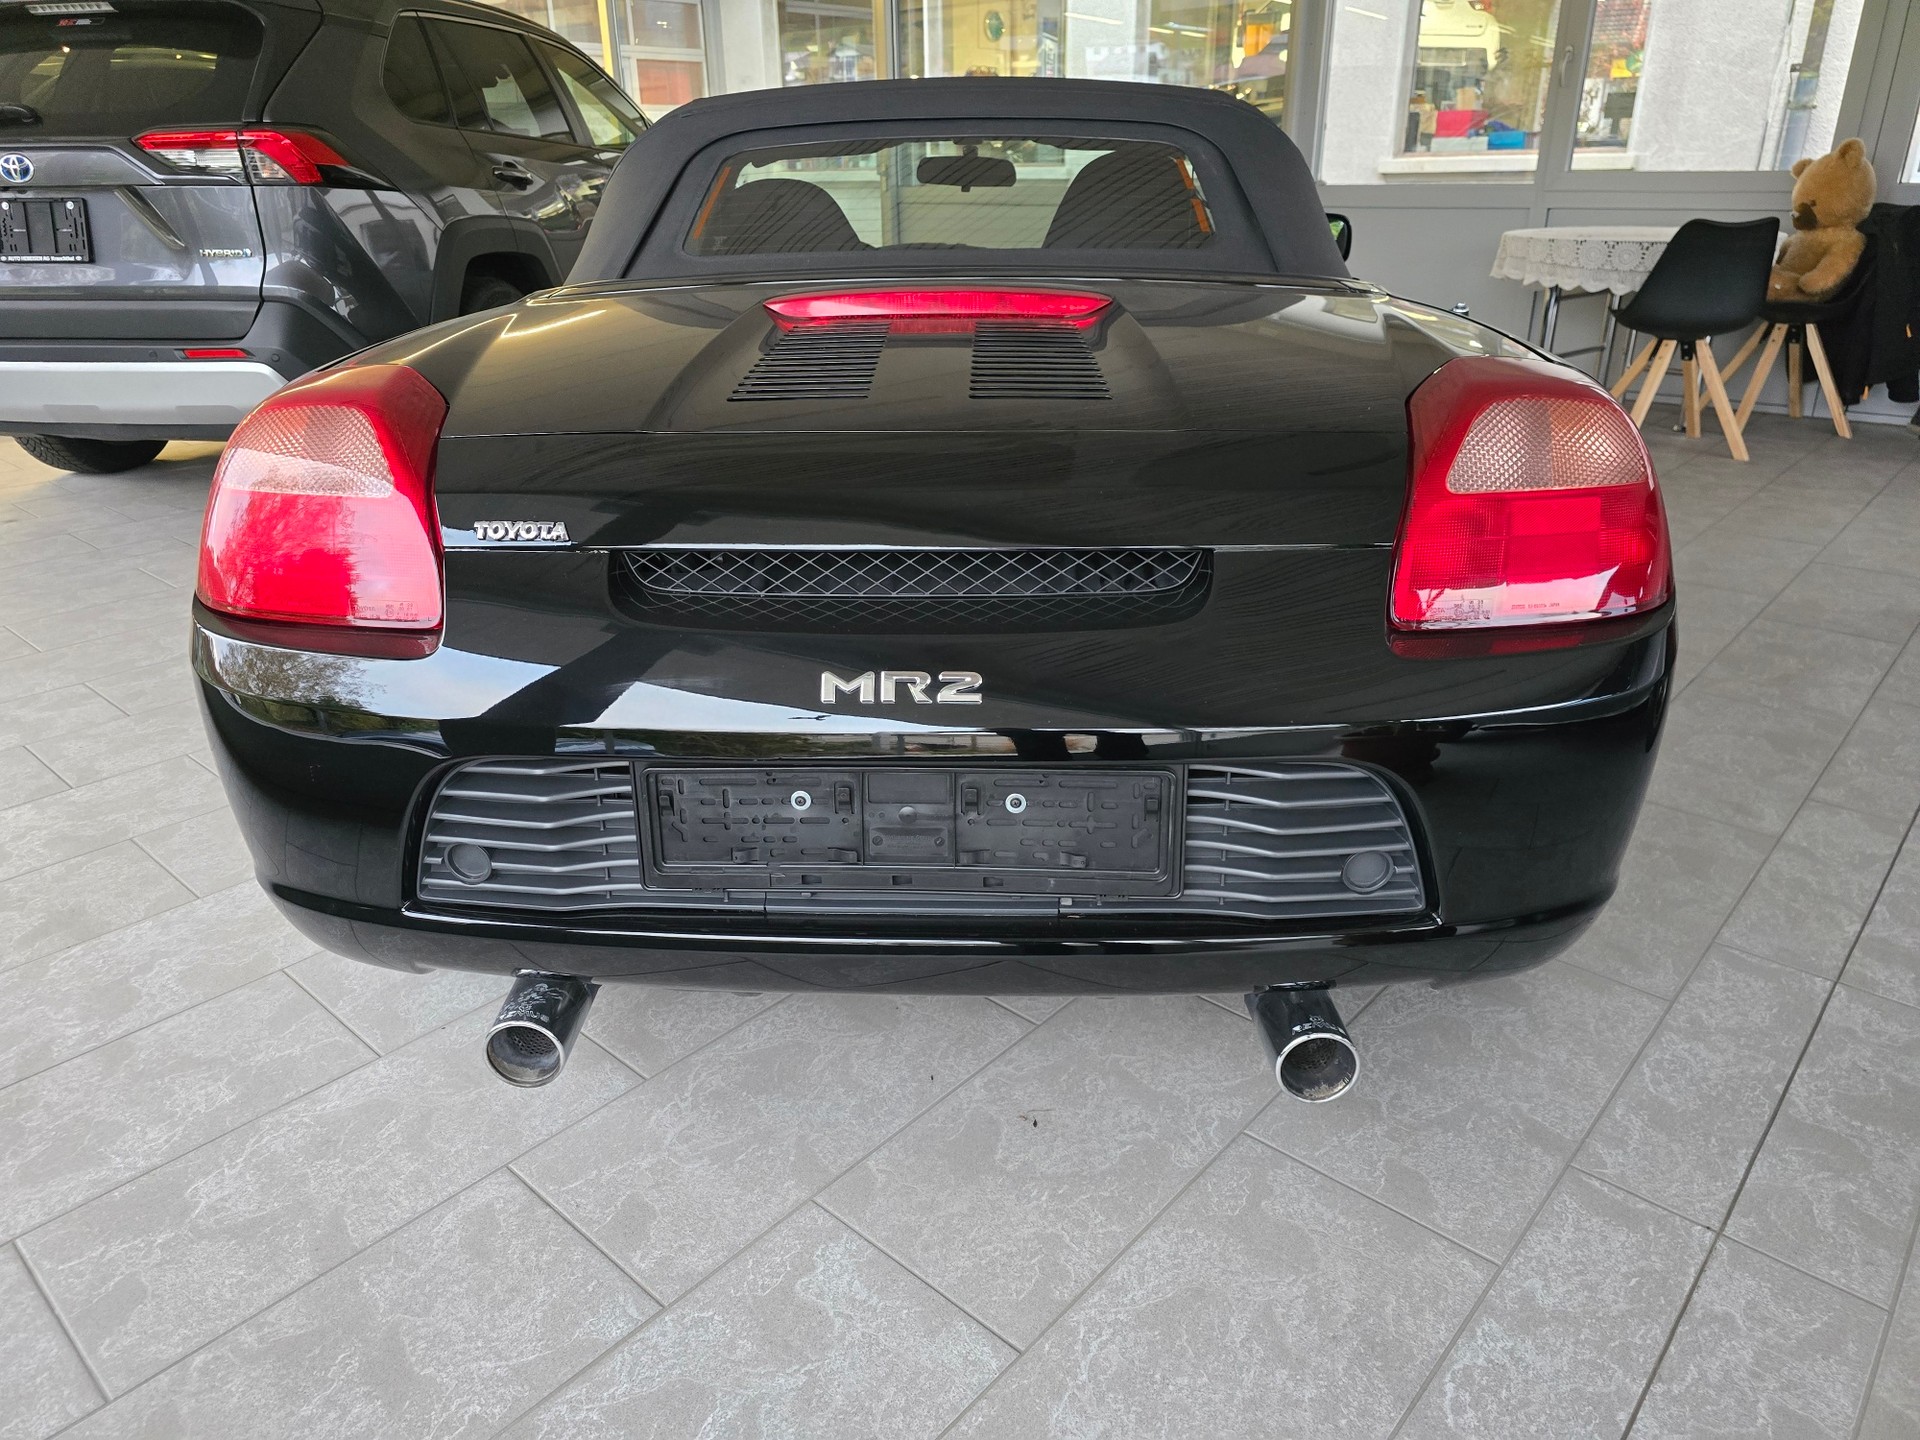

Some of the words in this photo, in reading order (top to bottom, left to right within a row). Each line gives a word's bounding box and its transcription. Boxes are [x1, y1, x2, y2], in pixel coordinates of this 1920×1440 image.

[199, 249, 243, 257] HYBRID
[473, 521, 570, 542] TOYOTA
[820, 670, 984, 705] MR2
